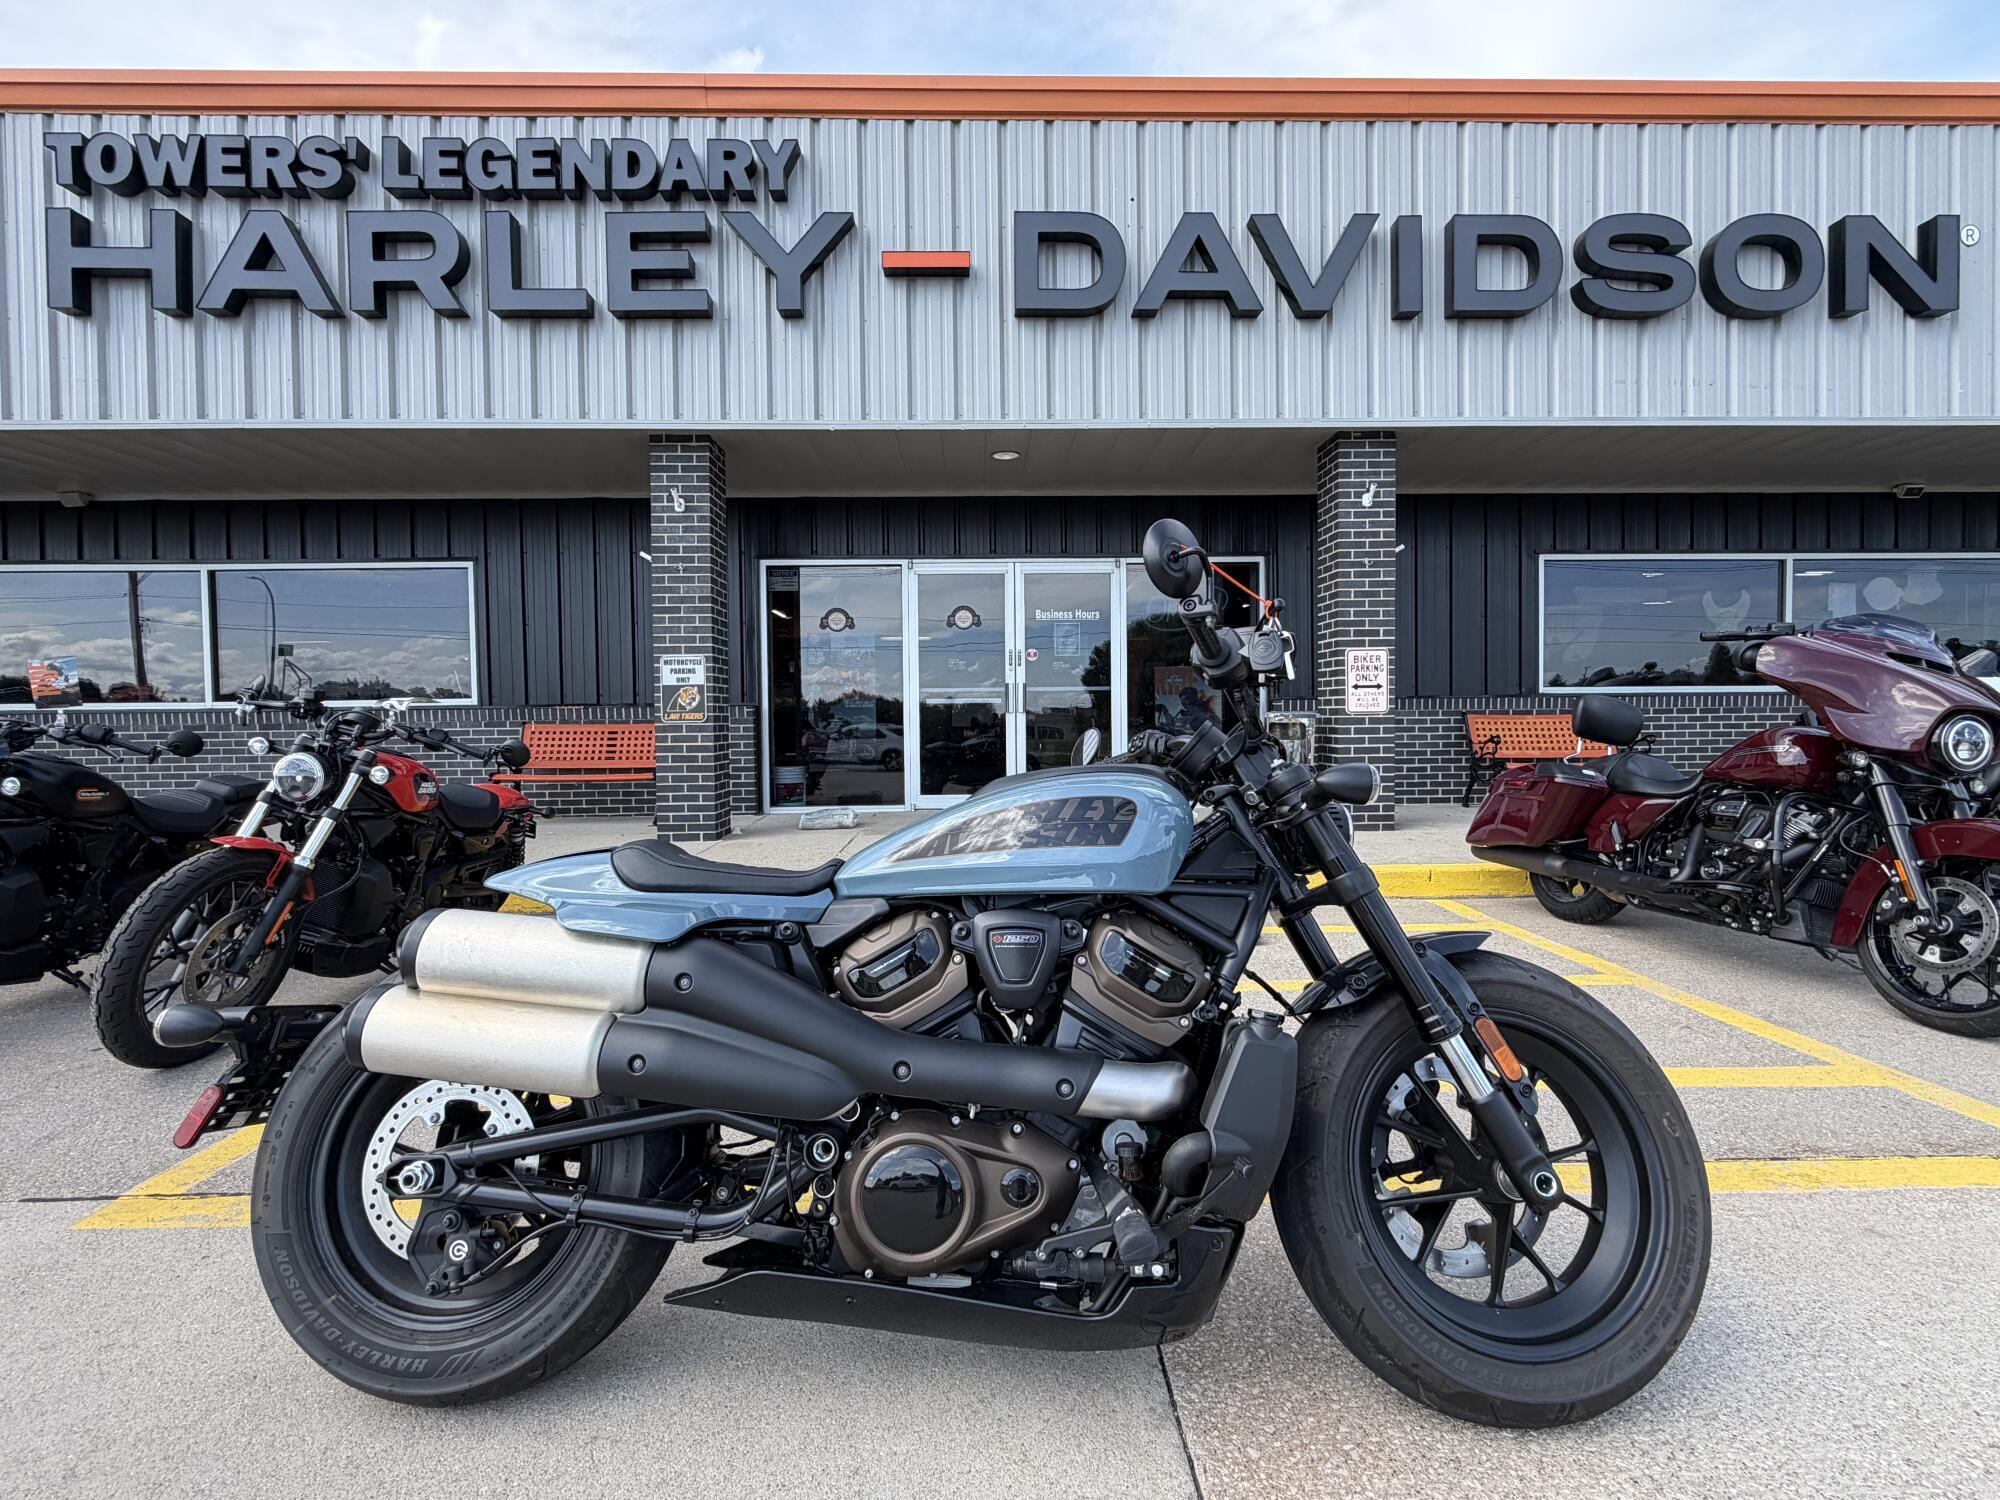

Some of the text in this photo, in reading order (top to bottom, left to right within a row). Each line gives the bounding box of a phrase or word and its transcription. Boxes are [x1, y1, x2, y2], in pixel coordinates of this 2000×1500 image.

[43, 131, 802, 201] TOWERS' LEGENDARY
[1035, 608, 1100, 619] Business Hours
[1354, 655, 1381, 664] BIKER
[1350, 664, 1384, 672] PARKING
[1356, 674, 1379, 682] ONLY
